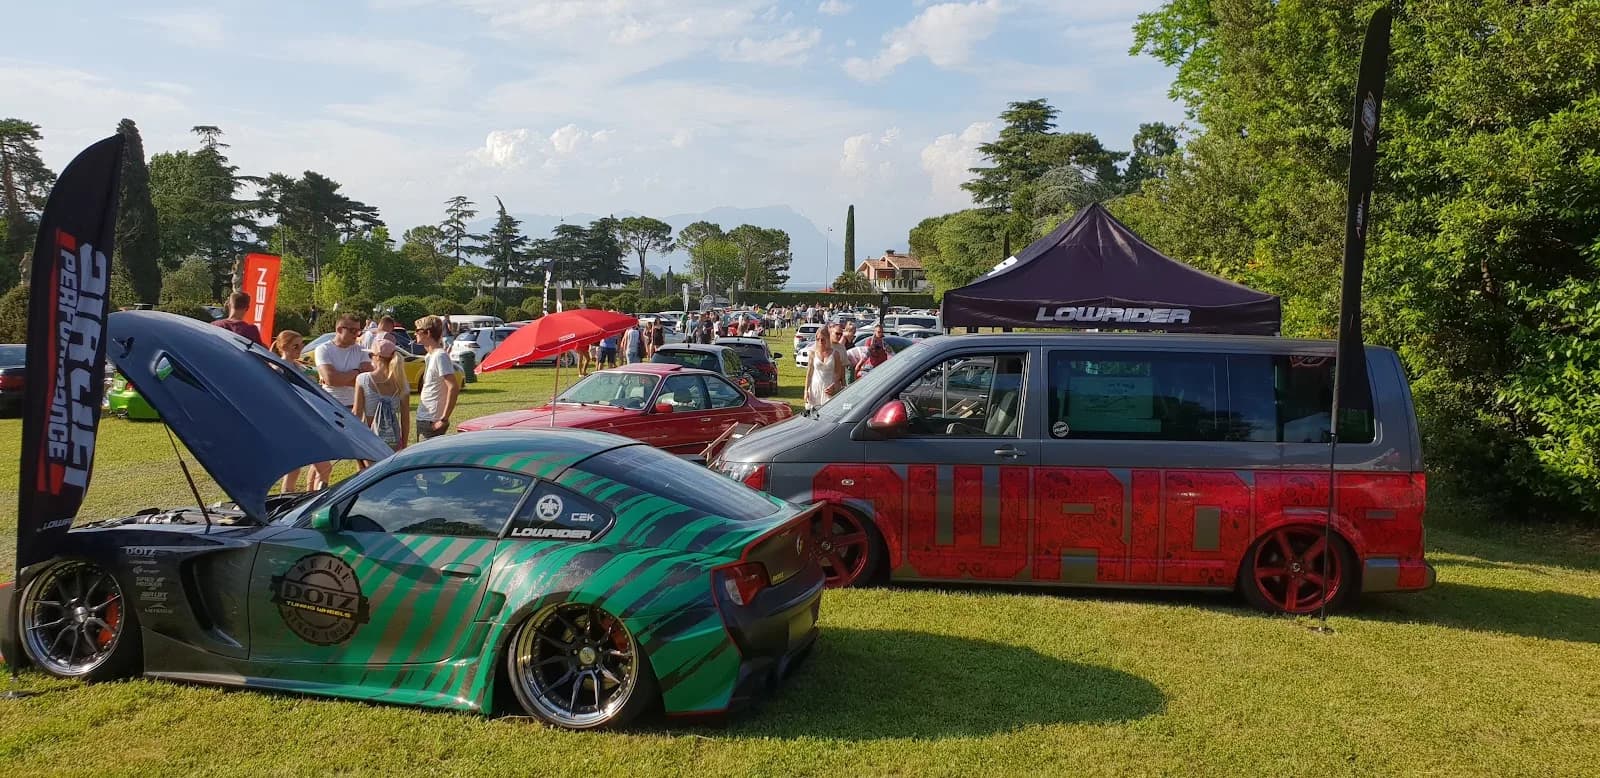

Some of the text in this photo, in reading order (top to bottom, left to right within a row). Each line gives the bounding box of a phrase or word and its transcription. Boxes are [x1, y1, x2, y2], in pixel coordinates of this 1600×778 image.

[1035, 306, 1191, 324] LOWRIDER
[511, 527, 592, 539] LOWRIDER
[325, 559, 352, 583] ARE
[284, 582, 356, 610] DOTZ
[316, 606, 352, 618] WHEELS
